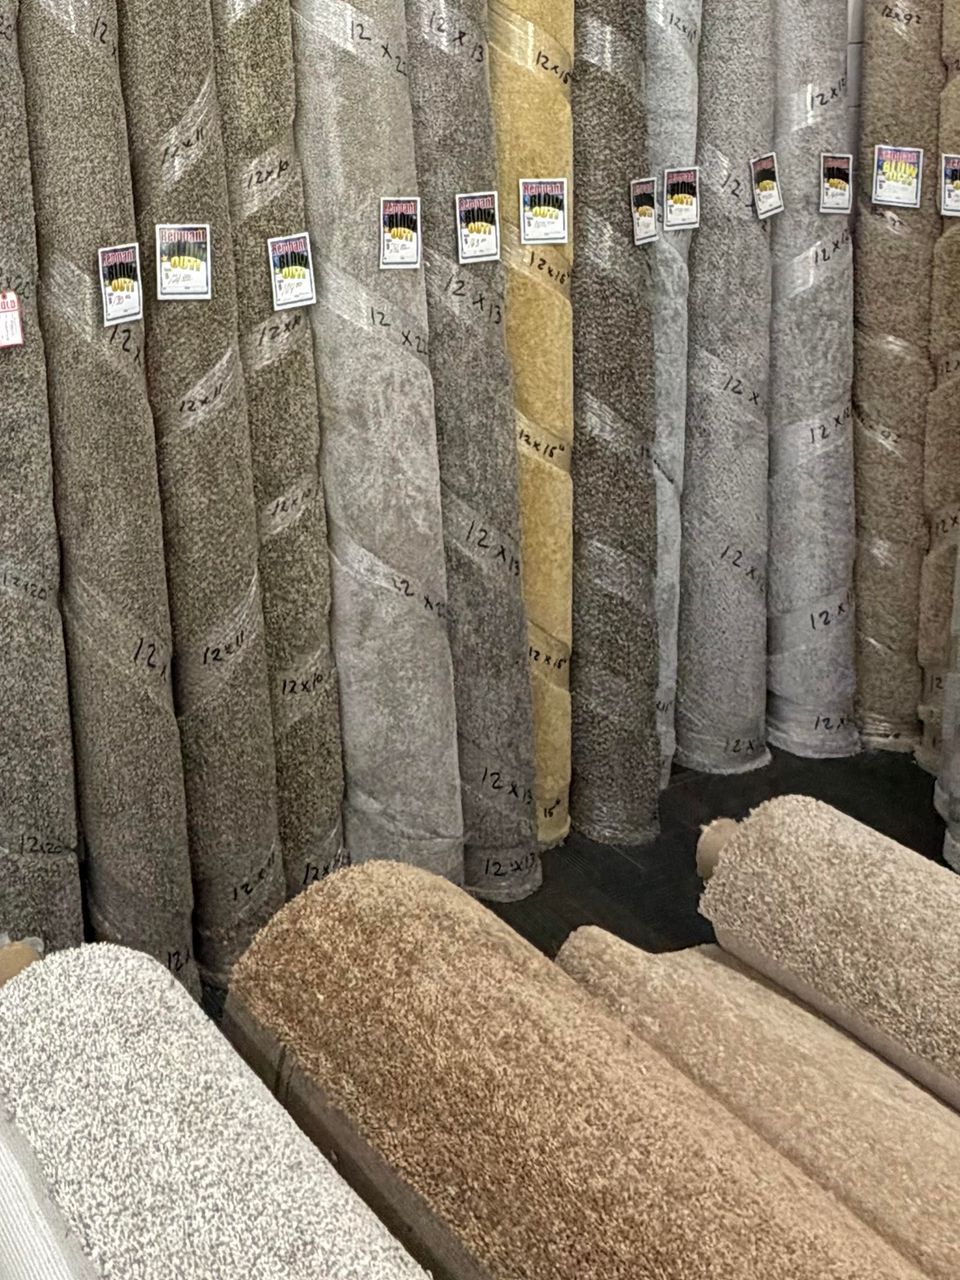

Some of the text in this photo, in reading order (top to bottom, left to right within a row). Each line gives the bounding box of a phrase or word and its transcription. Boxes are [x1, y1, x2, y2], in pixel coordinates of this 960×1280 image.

[92, 17, 108, 45] 12
[350, 22, 393, 60] 12 x
[428, 10, 485, 64] 12 13
[721, 172, 743, 199] 12
[160, 229, 206, 243] Remnant
[169, 255, 201, 272] OUT!
[110, 277, 135, 293] OUT!
[444, 276, 466, 298] 12
[472, 294, 486, 312] x
[109, 324, 132, 353] 12
[370, 306, 391, 327] 12
[401, 330, 413, 346] x
[722, 375, 760, 406] 12 x
[467, 520, 507, 562] 12 x
[720, 545, 743, 568] 12
[133, 637, 157, 668] 12
[481, 767, 520, 798] 12 x
[483, 858, 506, 878] 12
